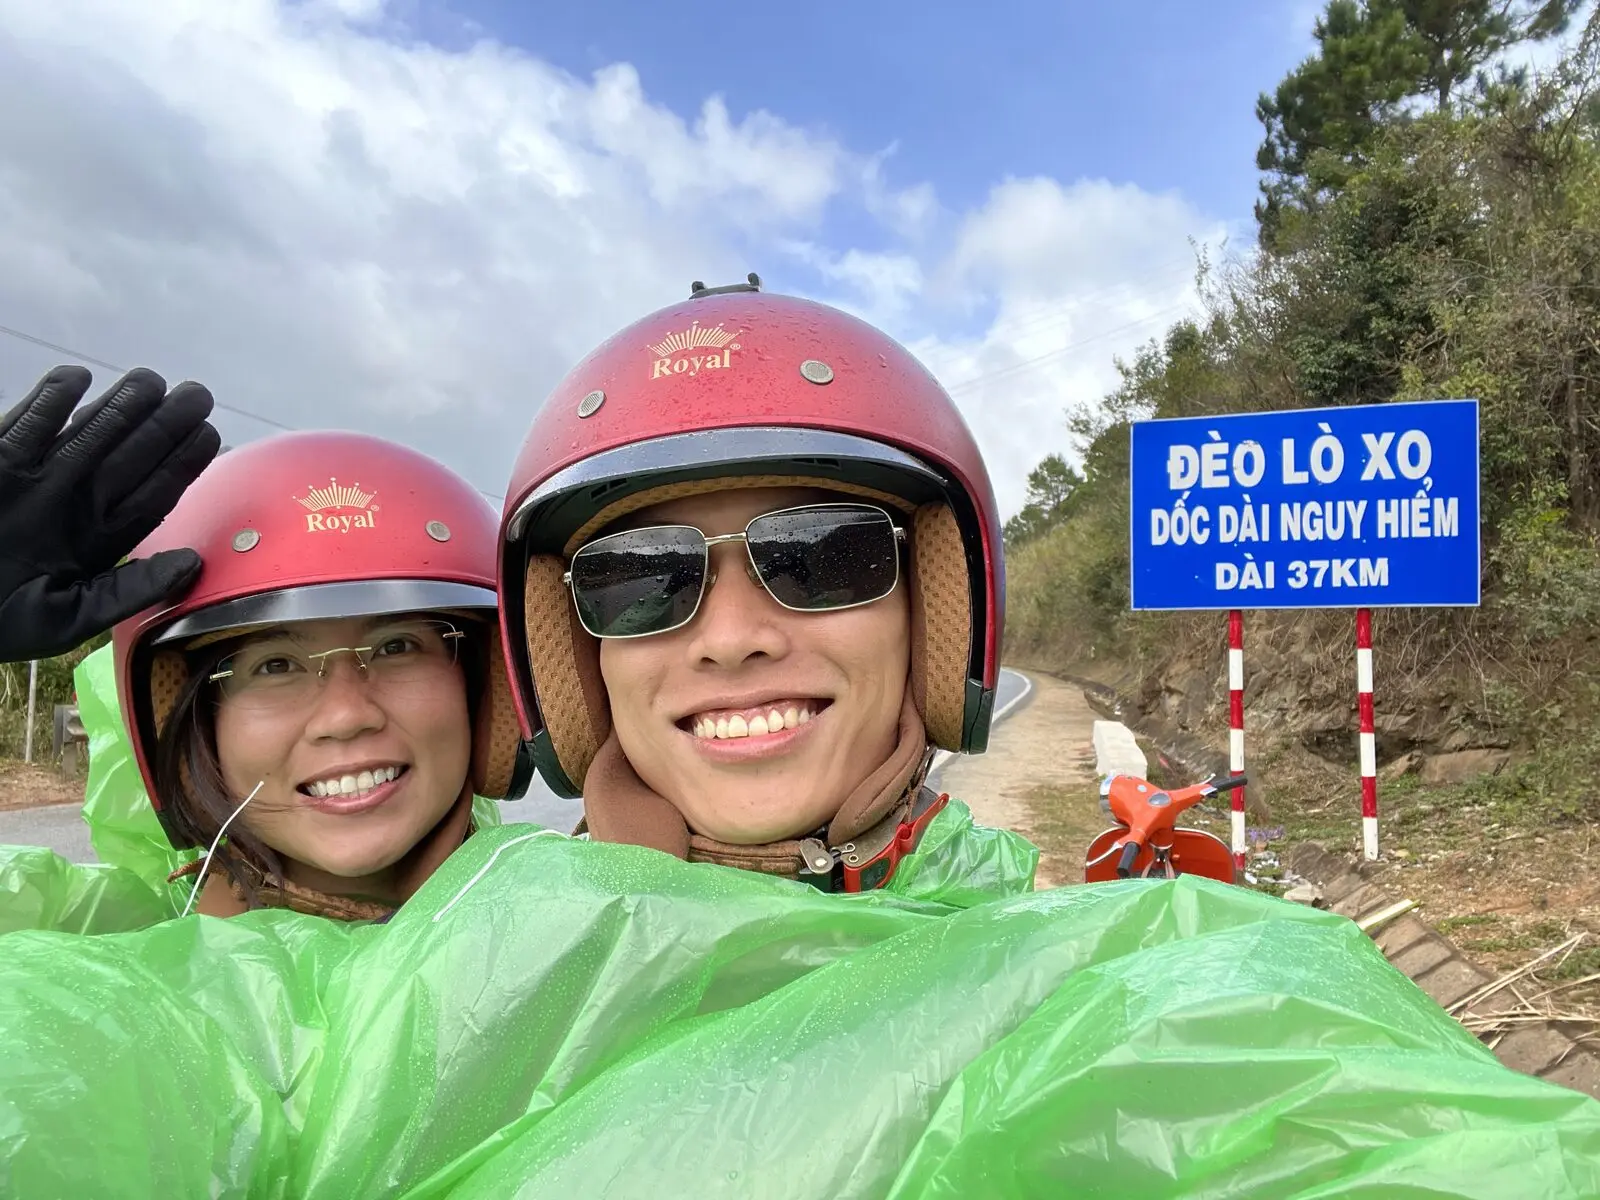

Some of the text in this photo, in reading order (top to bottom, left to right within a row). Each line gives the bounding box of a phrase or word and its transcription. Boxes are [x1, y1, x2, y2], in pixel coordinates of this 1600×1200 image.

[651, 349, 730, 380] Royal
[1167, 422, 1432, 491] ĐÈO LÒ XO
[305, 510, 376, 533] Royal
[1151, 476, 1459, 546] DỐC DÀI NGUY HIỂM
[1215, 553, 1389, 590] DÀI 37KM
